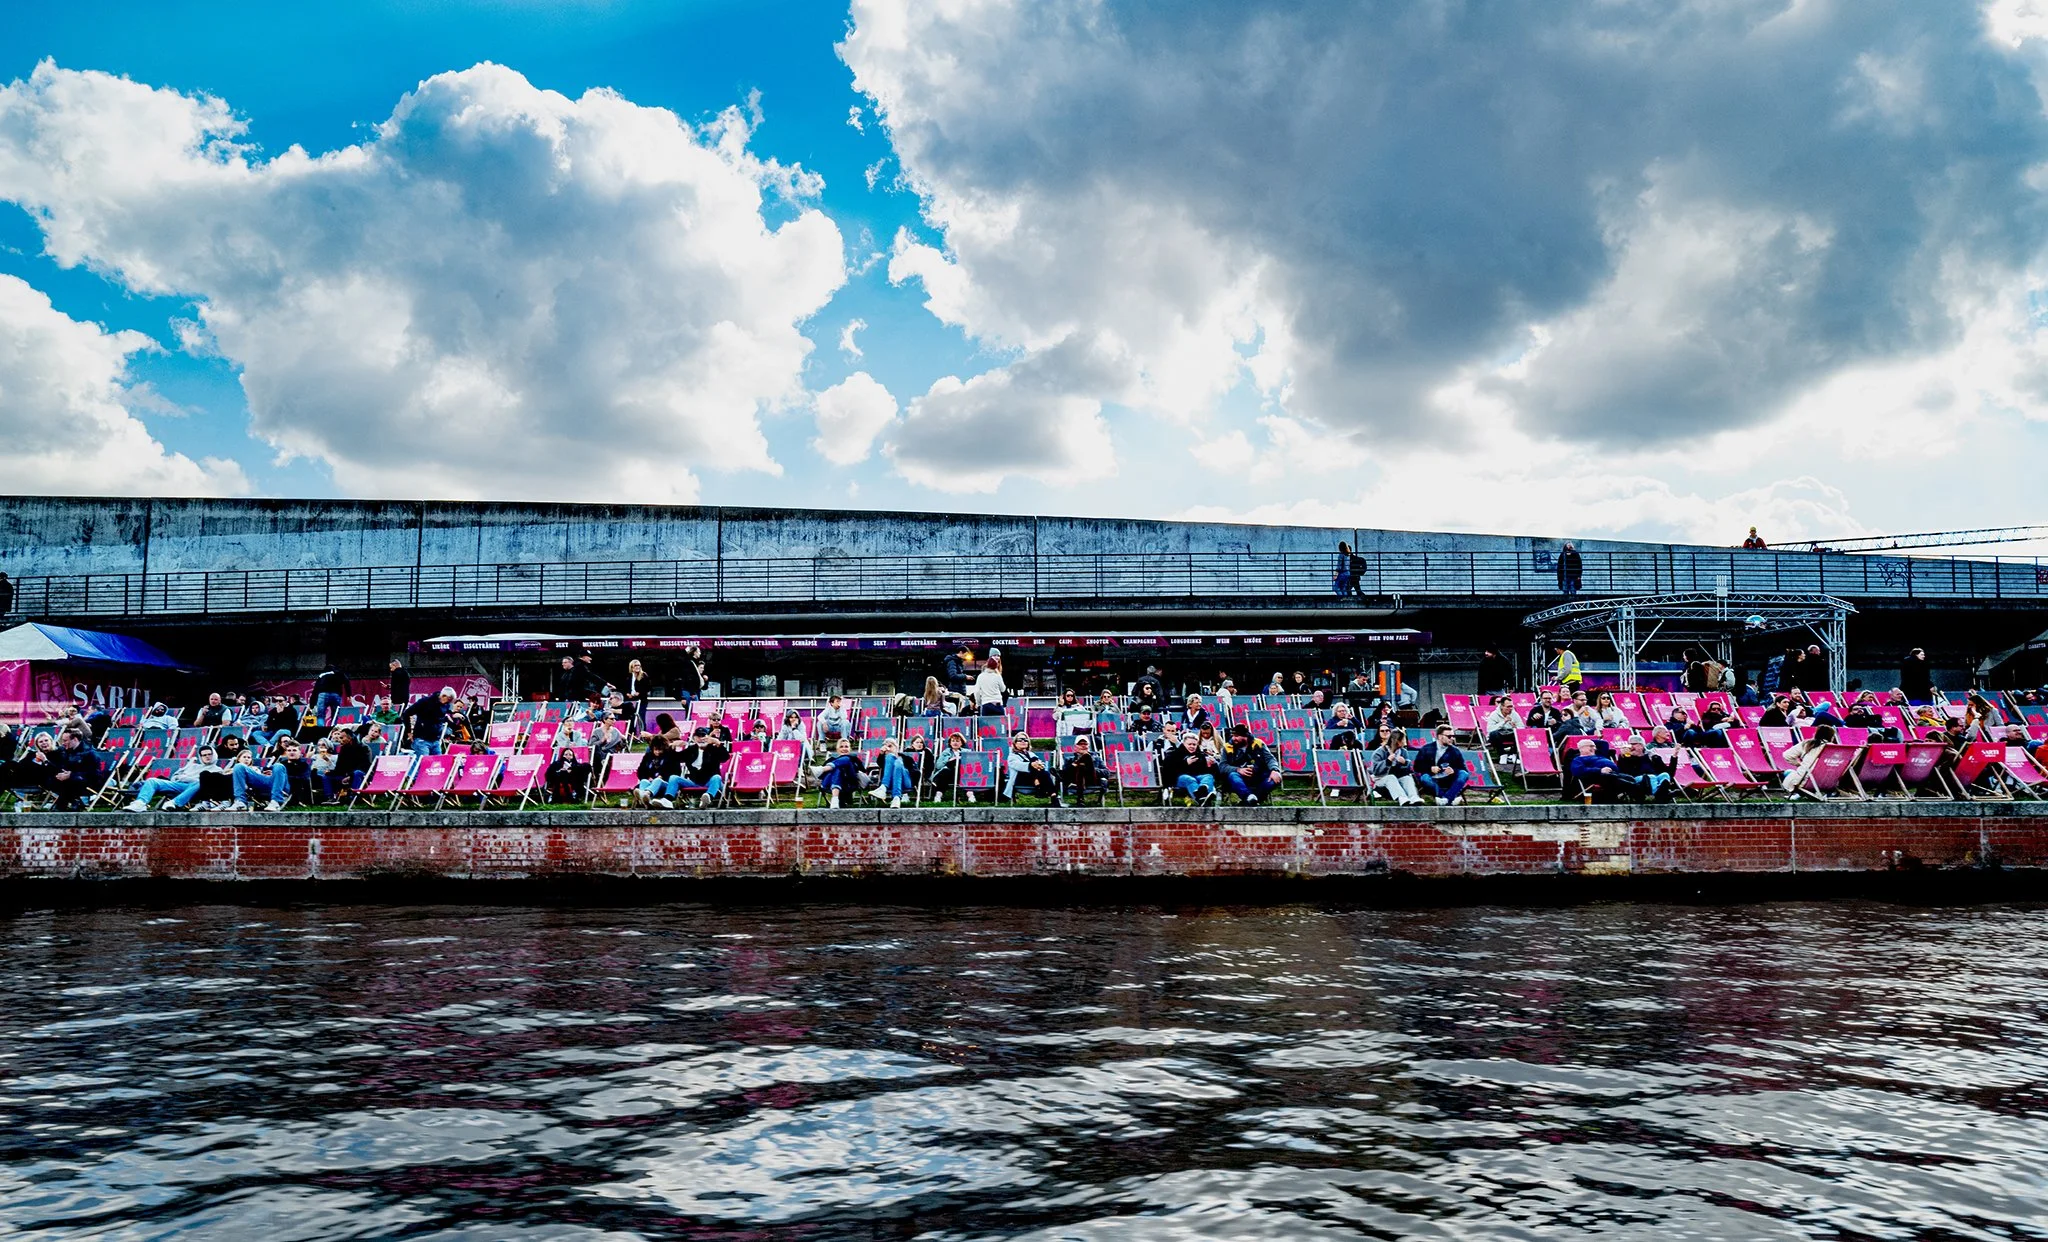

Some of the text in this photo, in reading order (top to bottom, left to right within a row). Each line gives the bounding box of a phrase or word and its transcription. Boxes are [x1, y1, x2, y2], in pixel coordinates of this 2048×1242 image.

[659, 639, 701, 648] HEISSGETRÄNKE
[751, 639, 779, 647] GETRÄNKE
[791, 639, 818, 647] SCHNÄPSE
[830, 639, 848, 647] SÄFTE
[900, 638, 938, 646] MIXGETRÄNKE
[1243, 636, 1262, 644] LIKÖRE
[1275, 635, 1314, 644] EISGETRÄNKE
[431, 642, 450, 650] LIKÖRE
[463, 641, 501, 650] EISGETRÄNKE
[582, 640, 619, 648] MIXGETRÄNKE
